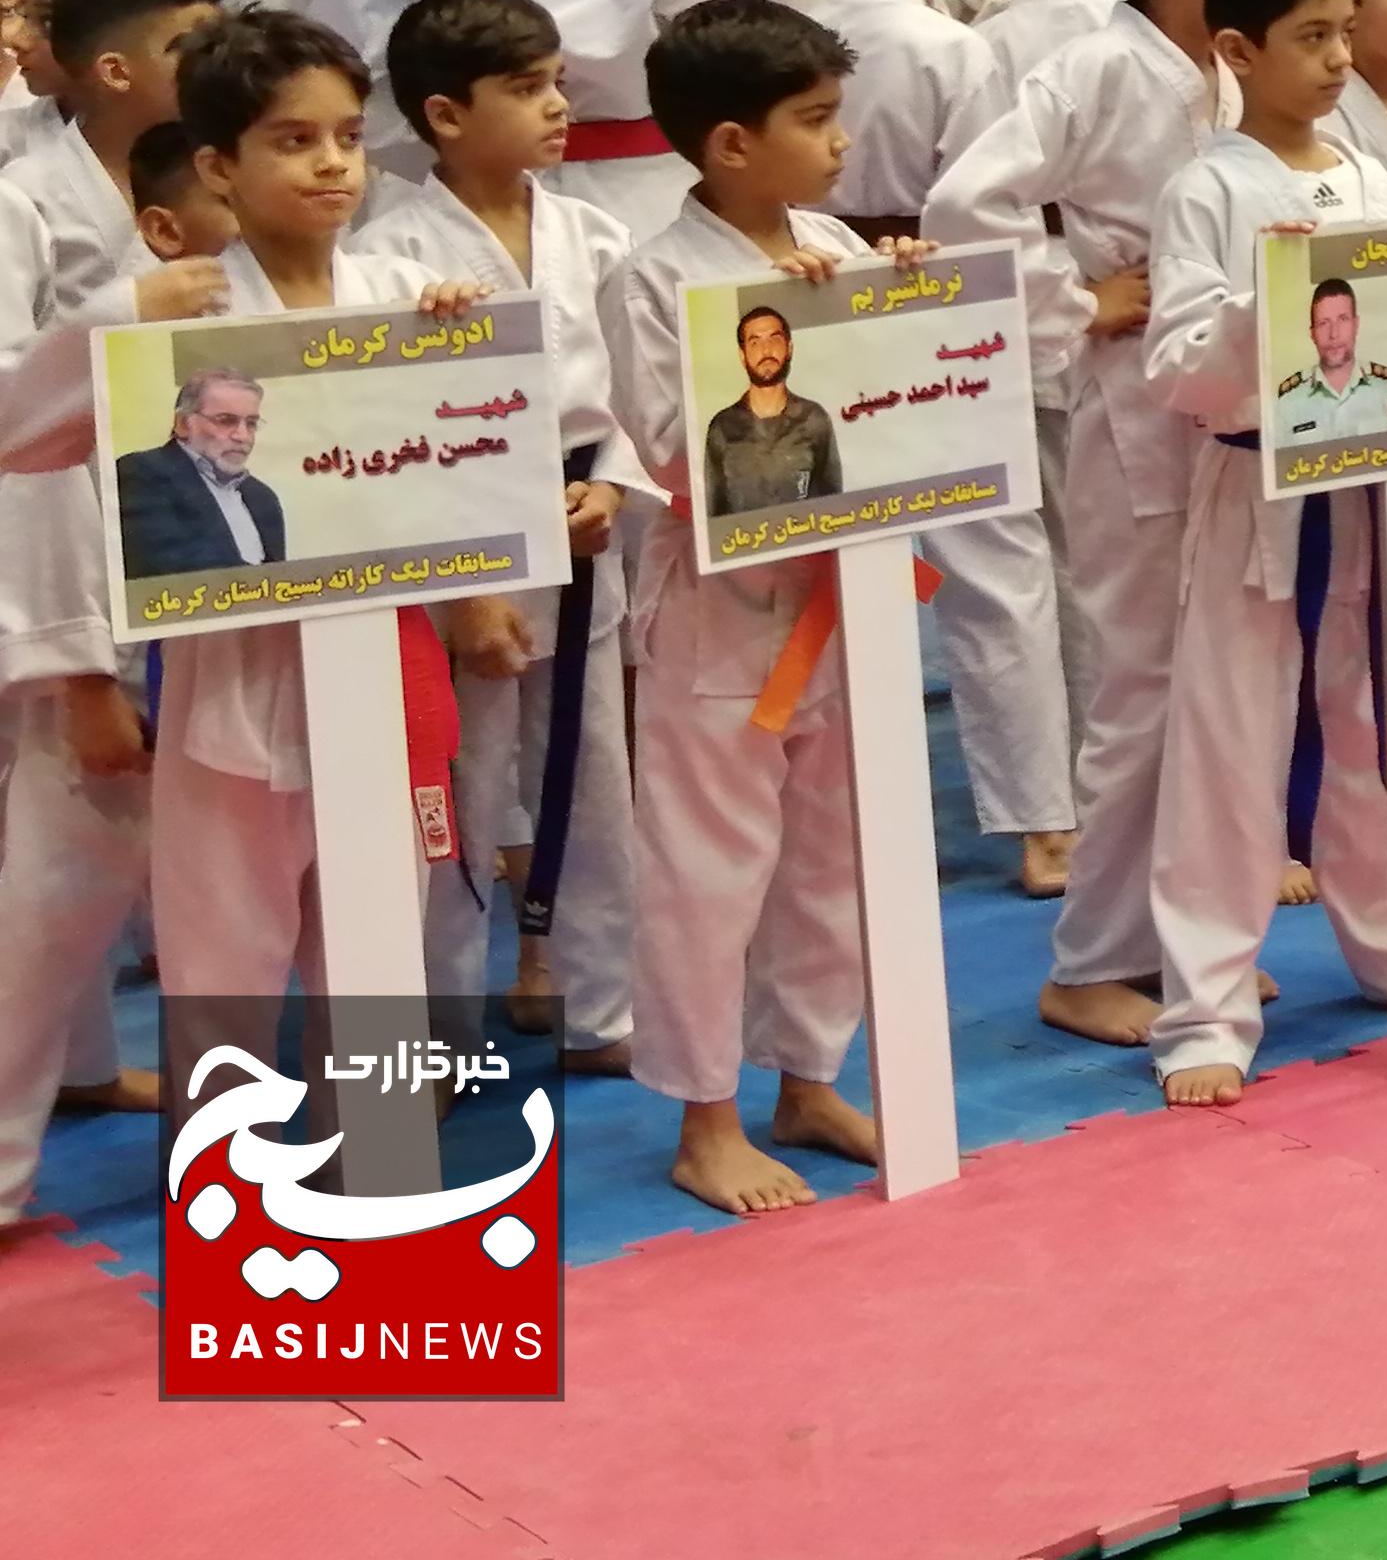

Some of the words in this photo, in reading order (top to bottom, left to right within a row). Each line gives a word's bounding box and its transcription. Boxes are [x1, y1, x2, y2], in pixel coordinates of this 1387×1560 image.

[303, 322, 391, 368] کرمان
[936, 331, 1005, 361] شهید
[907, 374, 952, 405] احمد
[957, 377, 989, 399] سید
[435, 389, 528, 421] شهید
[841, 392, 902, 422] حسینی
[302, 446, 355, 479] زاده
[362, 435, 431, 476] فخری
[437, 438, 510, 468] محسن
[860, 495, 902, 523] کاراته
[941, 482, 997, 505] مسابقات
[774, 512, 815, 544] استان
[819, 509, 856, 534] بسیج
[722, 521, 768, 554] کرمان
[328, 563, 385, 594] کاراته
[436, 551, 512, 578] مسابقات
[144, 585, 207, 621] کرمان
[213, 578, 269, 611] استان
[274, 577, 322, 603] بسیج
